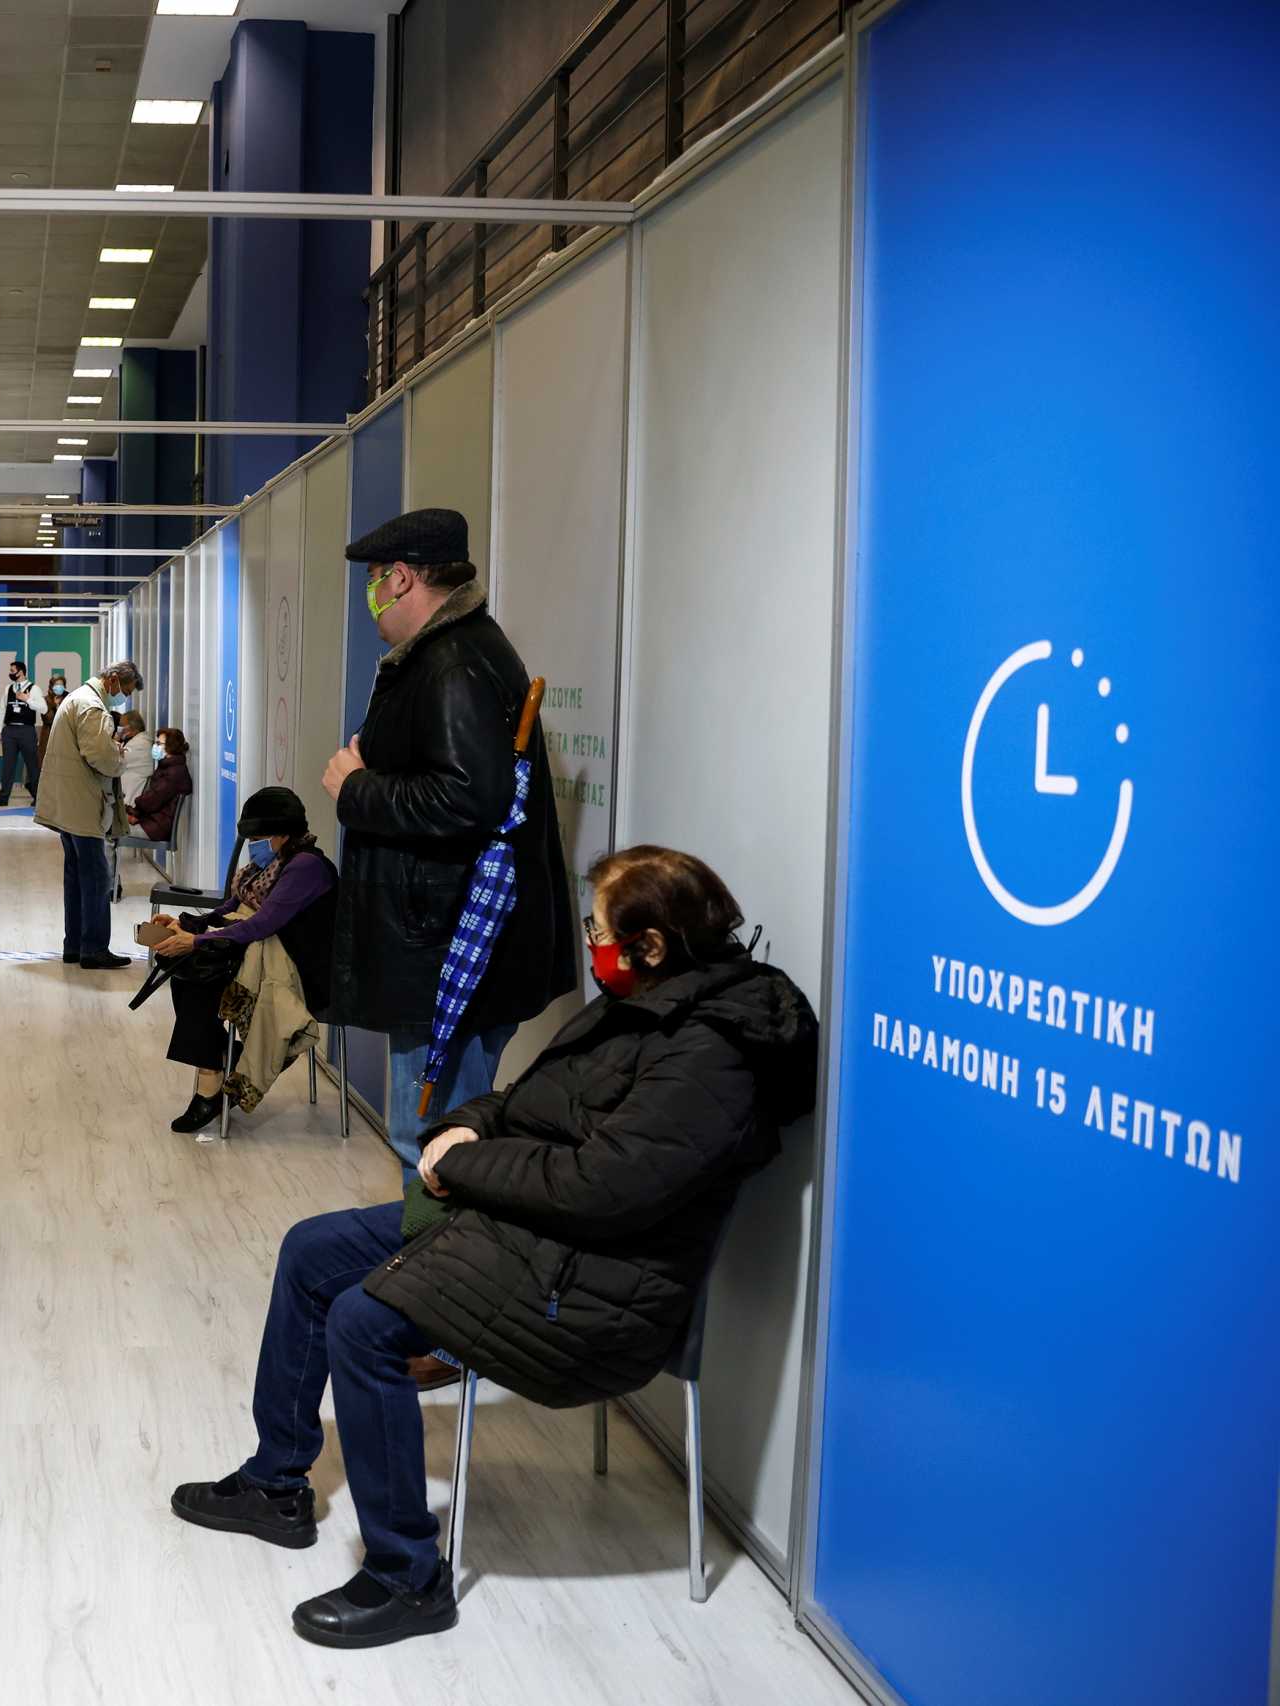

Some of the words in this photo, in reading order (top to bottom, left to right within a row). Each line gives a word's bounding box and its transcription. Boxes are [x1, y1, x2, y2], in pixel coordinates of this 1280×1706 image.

[932, 955, 1155, 1055] ΥΠΟΧΡΕΩΤΙΚΗ
[873, 1013, 1020, 1098] ΠΑΡΑΜΟΝΗ
[1035, 1067, 1067, 1115] 15
[1084, 1086, 1242, 1183] ΛΕΠΤΩΝ
